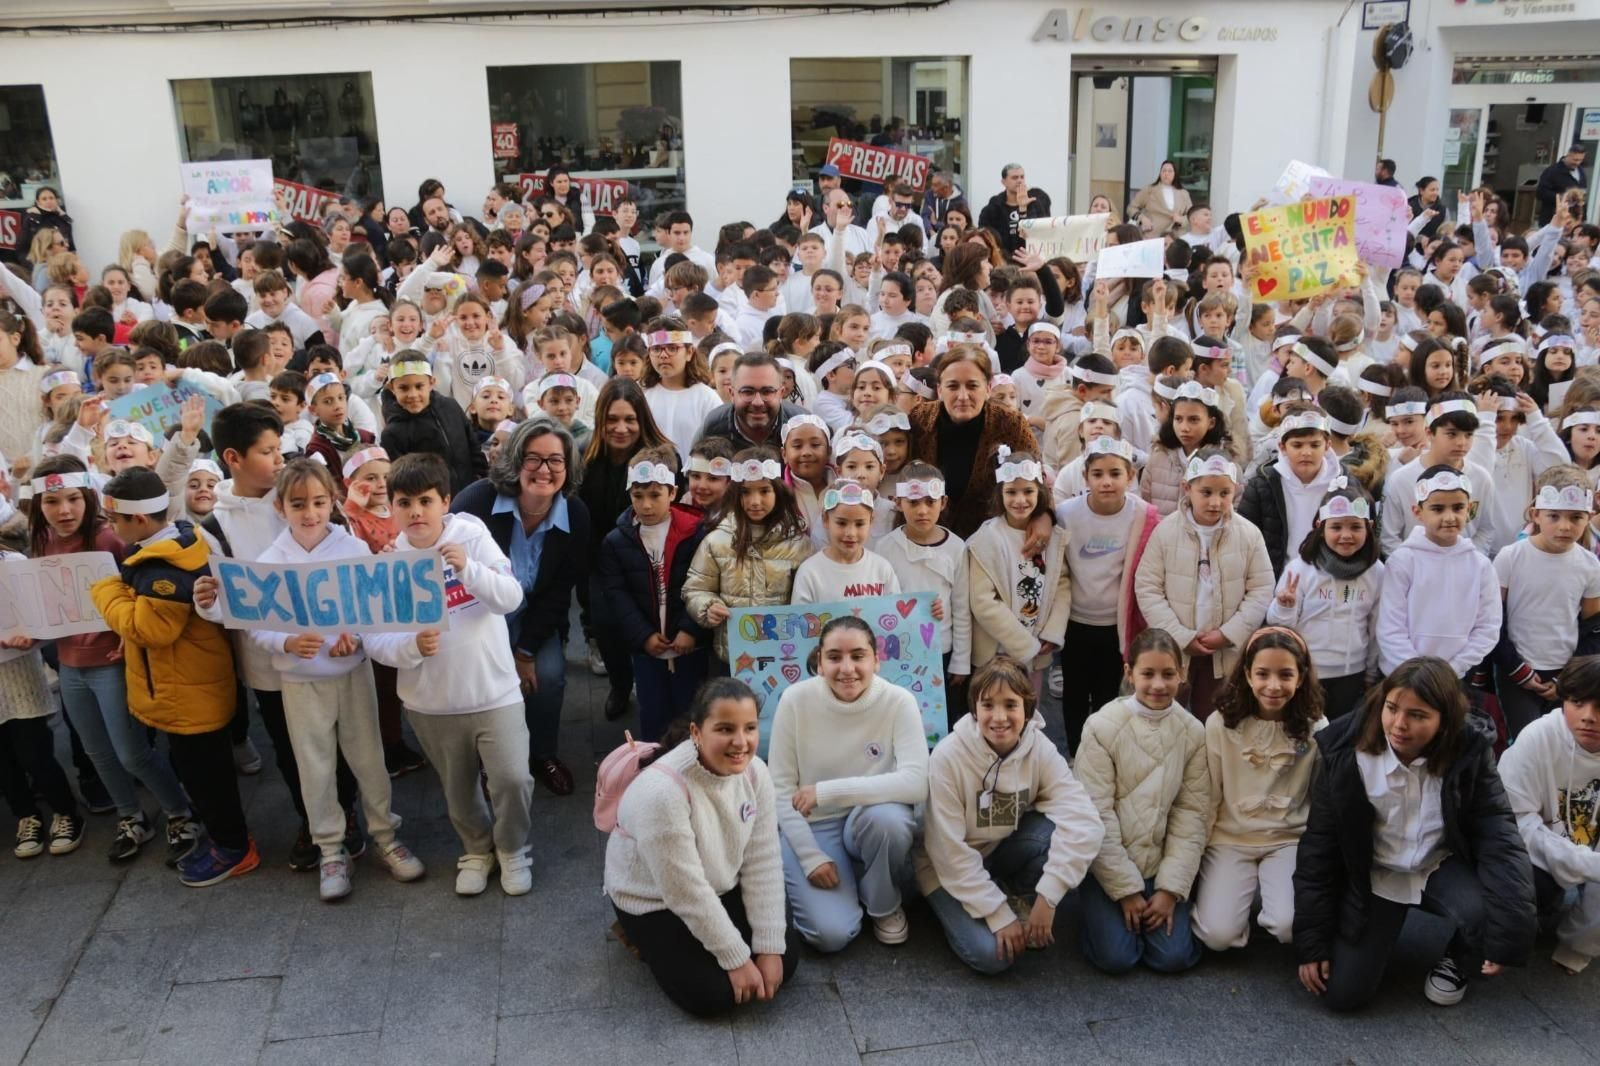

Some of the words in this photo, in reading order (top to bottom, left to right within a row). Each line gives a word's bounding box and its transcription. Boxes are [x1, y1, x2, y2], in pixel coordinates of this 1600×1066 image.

[1032, 8, 1211, 42] Alonso
[1503, 5, 1518, 17] by
[1217, 26, 1280, 42] CALZADOS
[1511, 71, 1555, 83] Alonso
[850, 147, 926, 188] REBAJAS
[207, 178, 253, 194] AMOR
[1247, 213, 1272, 236] EL
[1286, 197, 1350, 227] MUNDO
[1251, 226, 1349, 265] NECESITA
[1288, 261, 1335, 292] PAZ
[218, 558, 443, 627] EXIGIMOS
